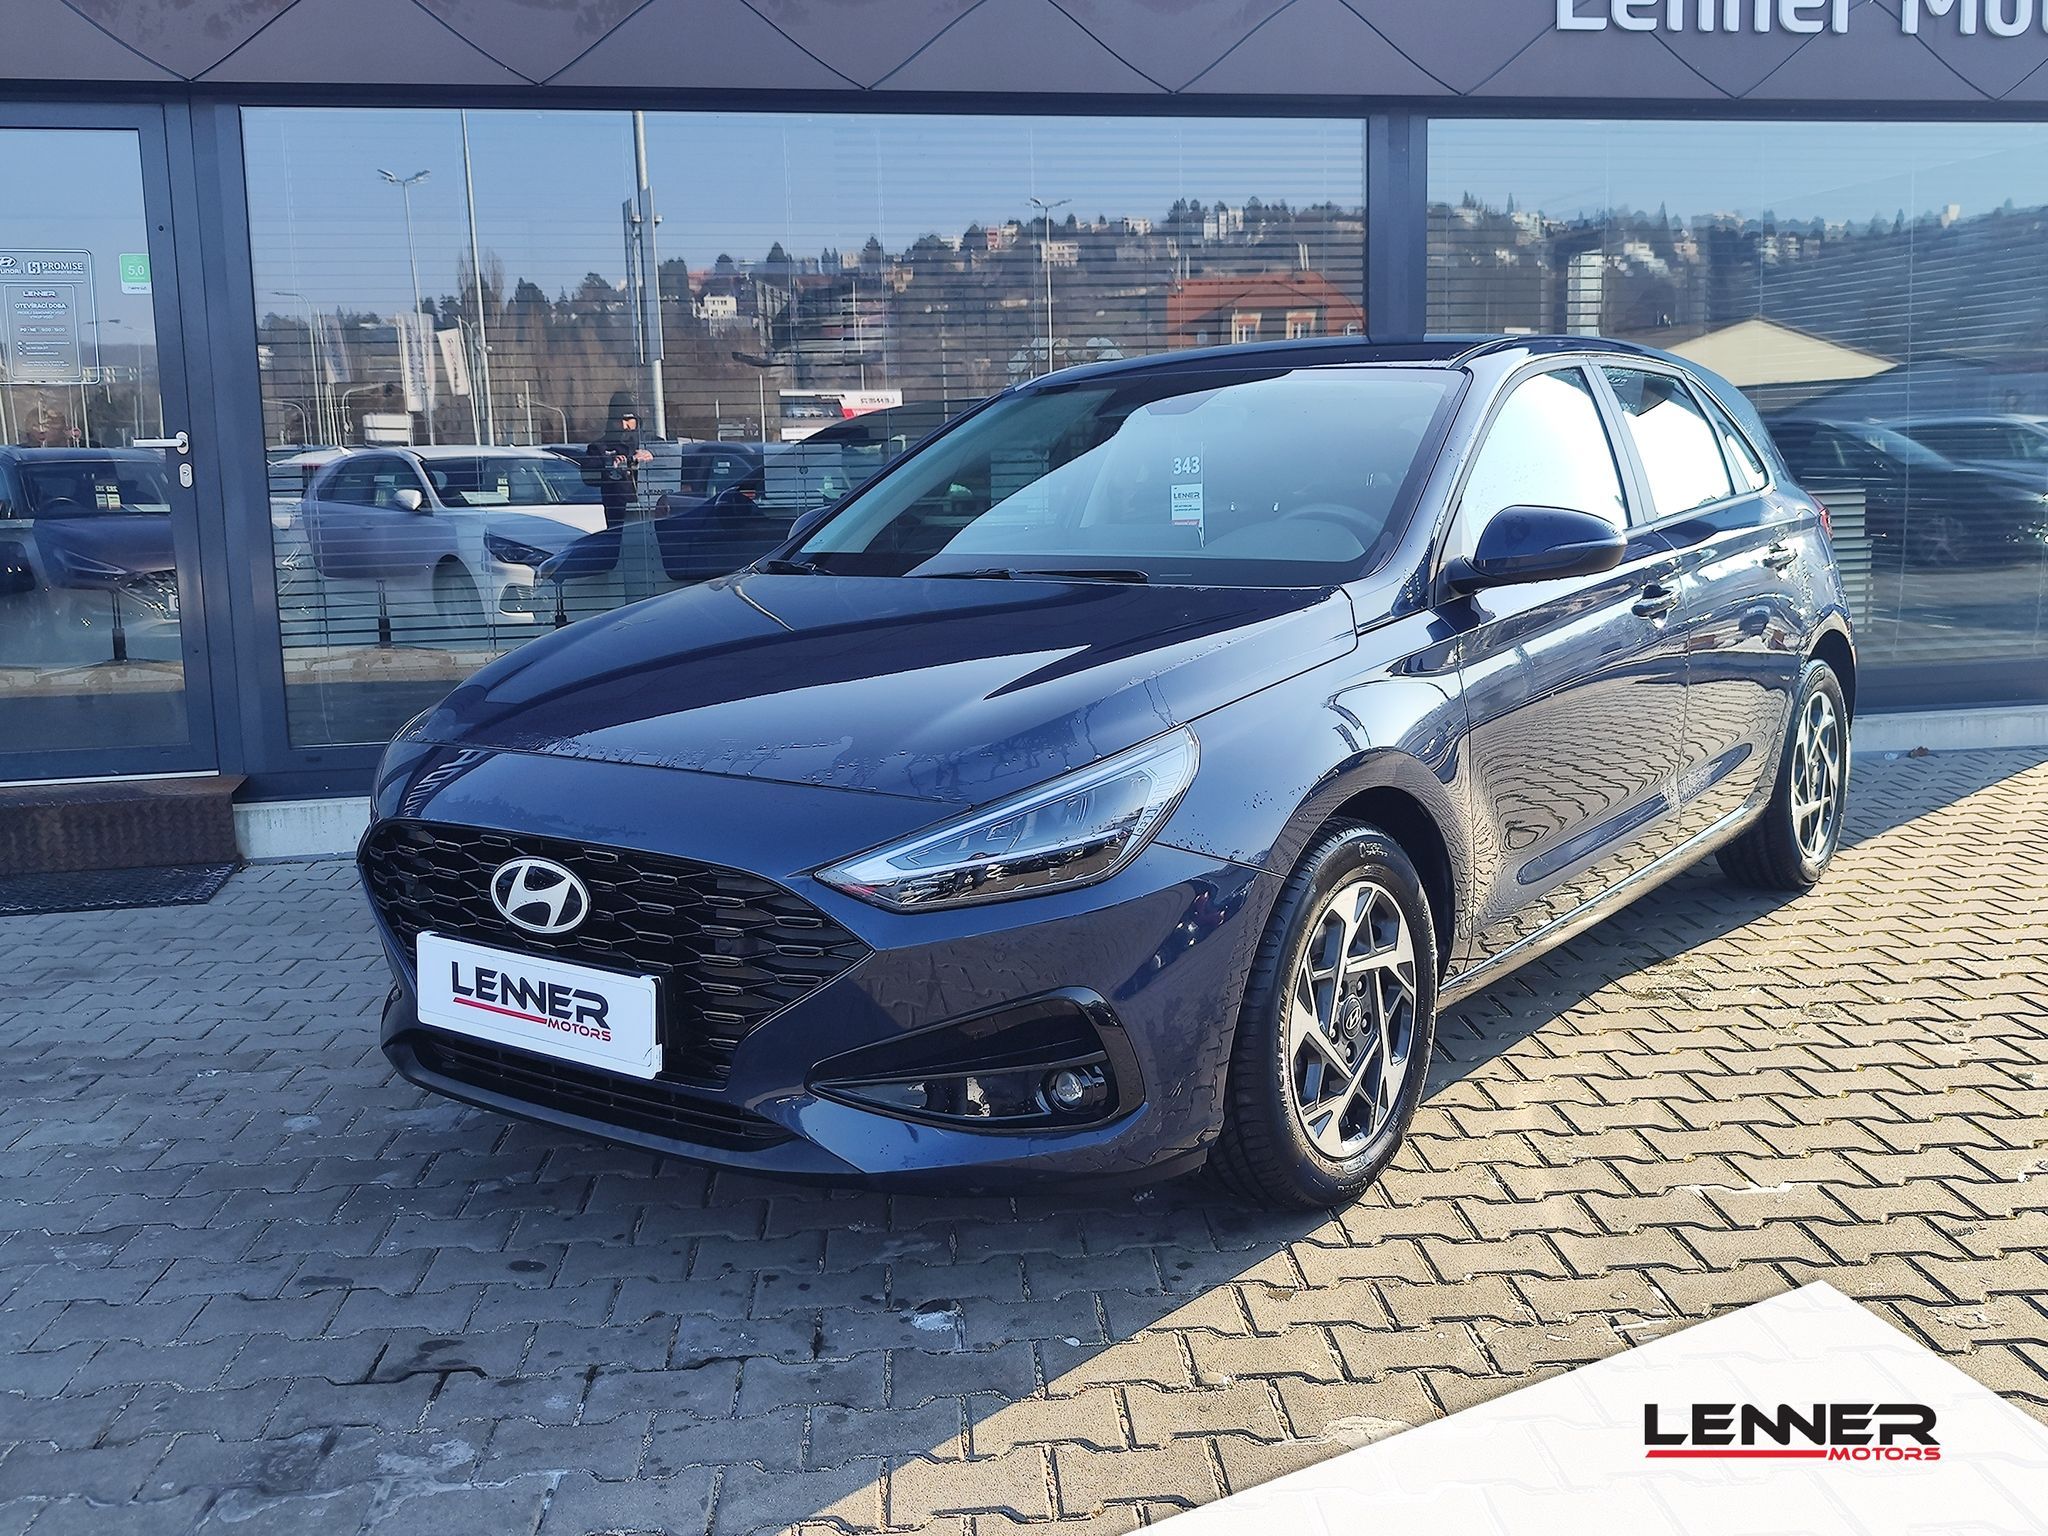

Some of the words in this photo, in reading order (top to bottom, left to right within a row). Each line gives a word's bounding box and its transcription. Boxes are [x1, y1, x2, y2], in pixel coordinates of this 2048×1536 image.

[1902, 0, 2048, 37] Mo
[42, 262, 83, 270] PROMISE
[1173, 456, 1200, 475] 343
[451, 961, 611, 1029] LENNER
[547, 1017, 612, 1042] MOTORS
